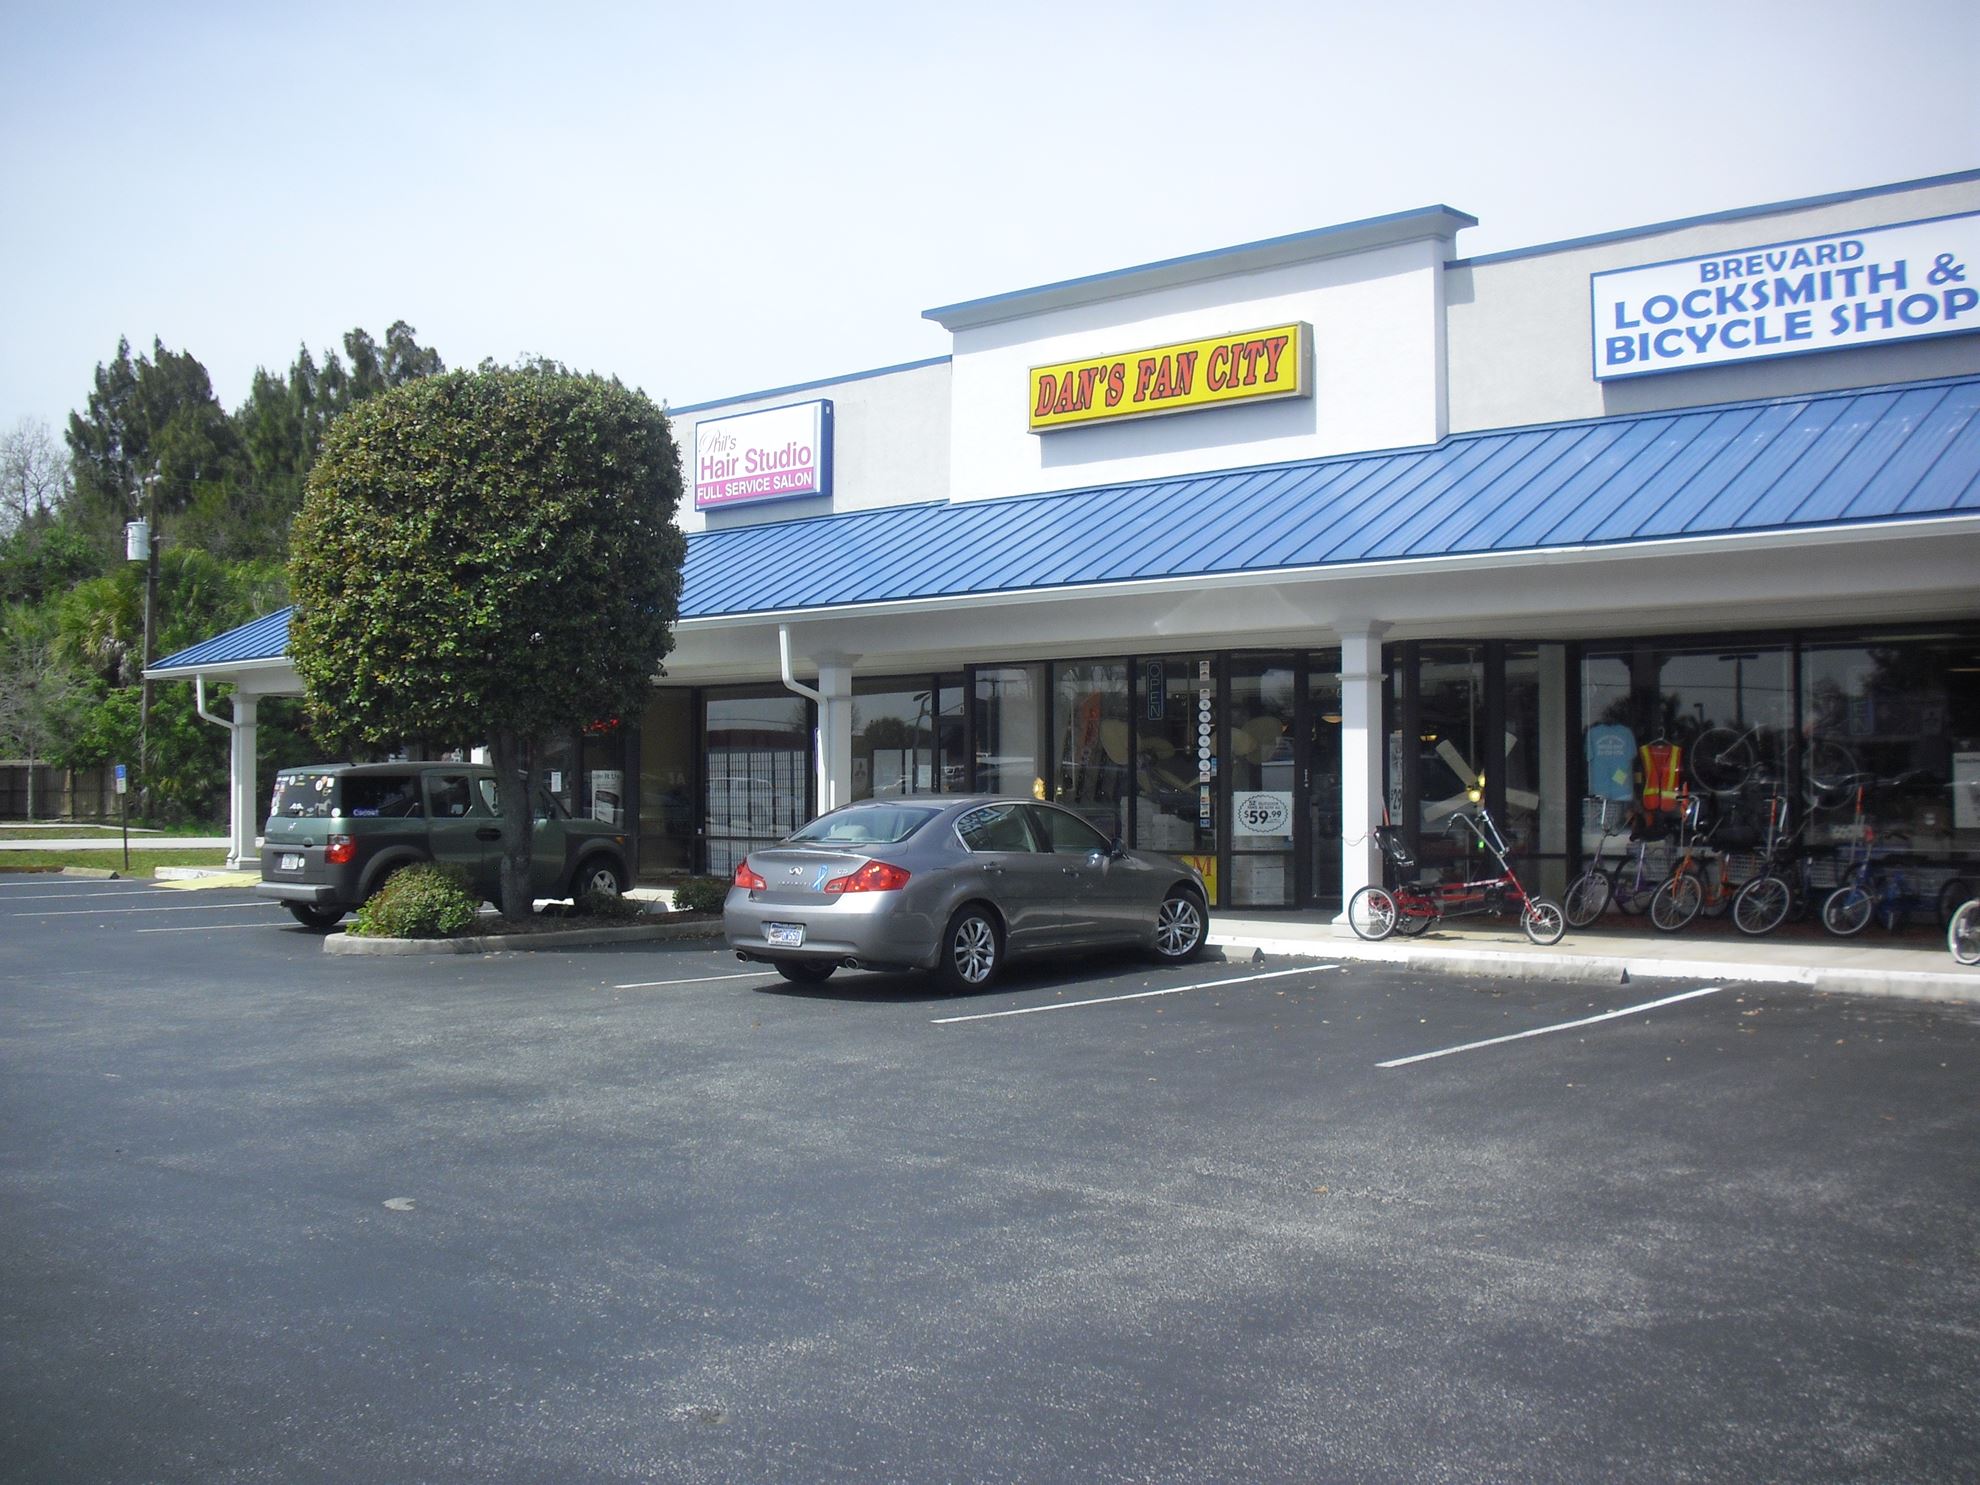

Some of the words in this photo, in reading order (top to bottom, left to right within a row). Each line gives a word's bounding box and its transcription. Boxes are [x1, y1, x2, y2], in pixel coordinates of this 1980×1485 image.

[1700, 240, 1865, 283] BREVARD
[1614, 260, 1907, 330] LOCKSMITH
[1926, 252, 1966, 285] &
[1606, 310, 1813, 365] BICYCLE
[1830, 287, 1979, 337] SHOP
[1034, 363, 1125, 417] DAN'S
[1133, 350, 1199, 402] FAN
[1206, 335, 1289, 392] CITY
[699, 430, 737, 454] Phil's
[701, 453, 739, 481] Hair
[745, 442, 811, 473] Studio
[697, 487, 722, 501] FULL
[725, 479, 770, 497] SERVICE
[773, 472, 812, 490] SALON
[1149, 664, 1161, 718] OPEN
[1244, 810, 1282, 825] $59.99
